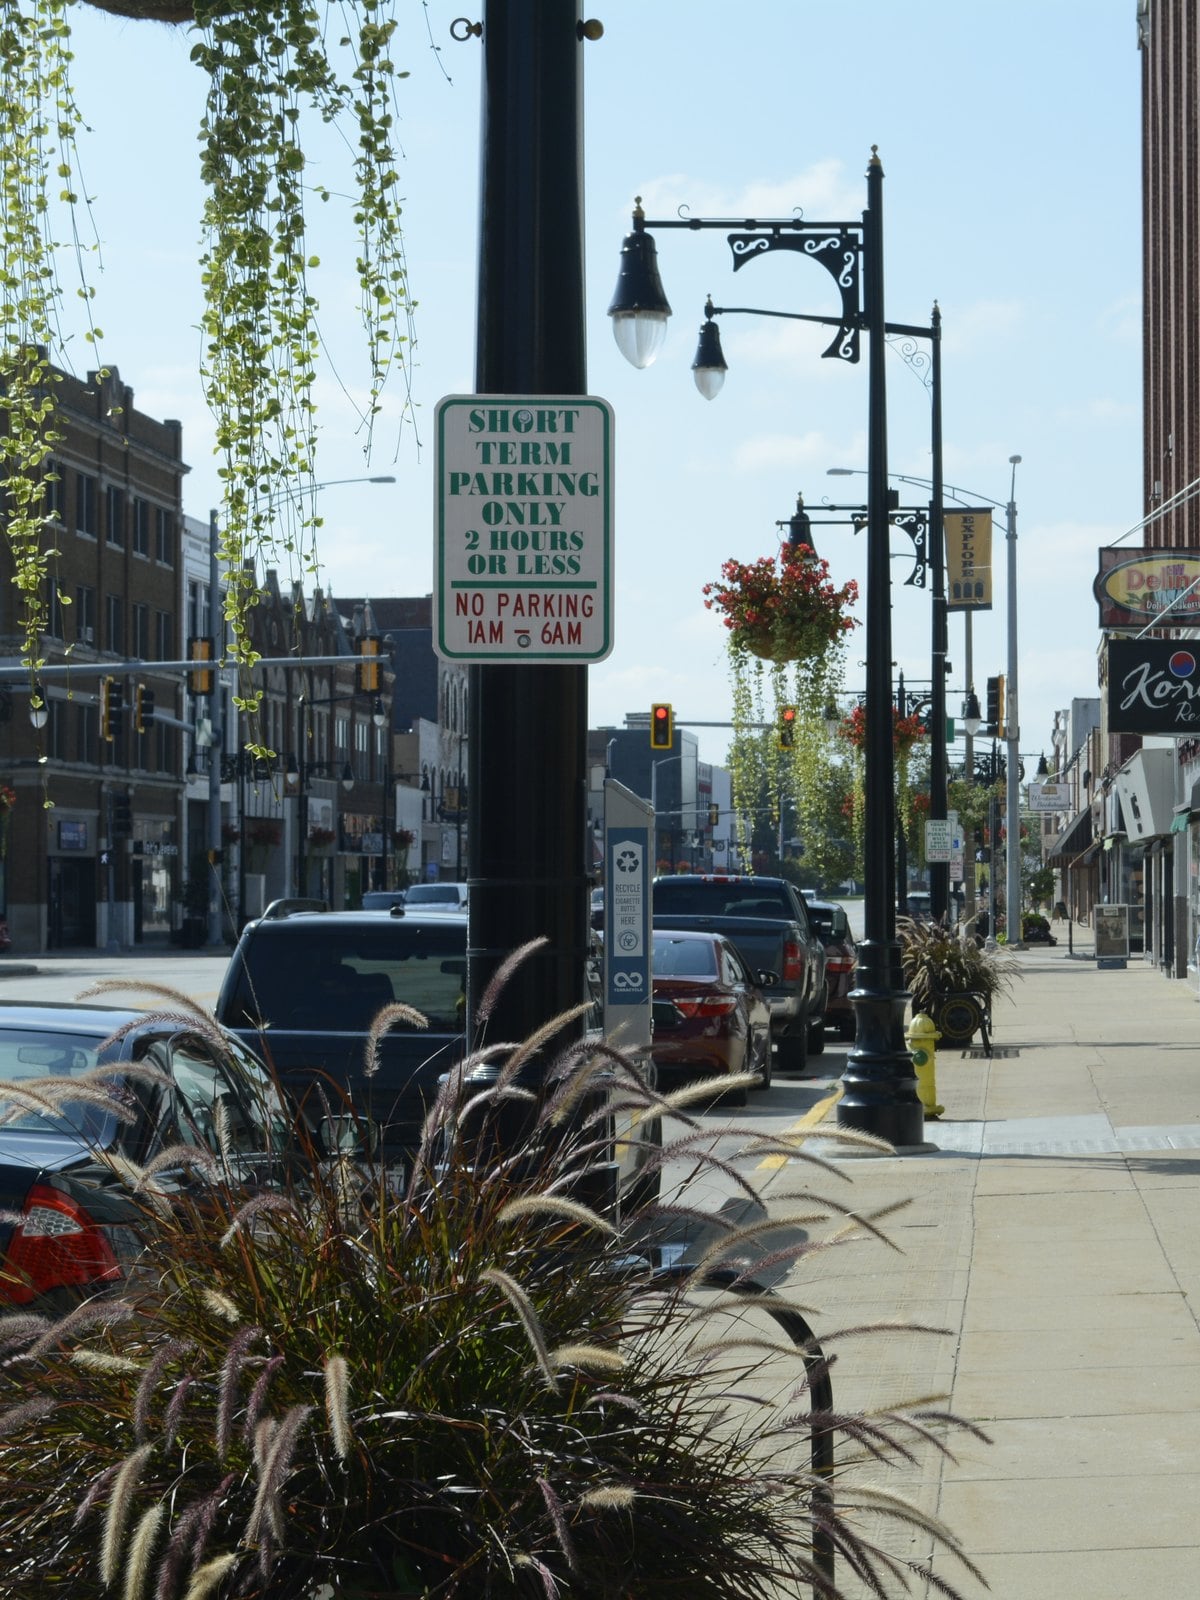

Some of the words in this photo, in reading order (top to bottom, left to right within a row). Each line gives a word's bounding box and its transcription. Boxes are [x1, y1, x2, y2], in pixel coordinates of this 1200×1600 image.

[468, 409, 579, 433] SHORT
[476, 441, 572, 465] TERM
[448, 472, 600, 496] PARKING
[482, 501, 566, 525] ONLY
[464, 530, 480, 550] 2
[489, 530, 584, 551] HOURS
[961, 516, 975, 577] EXPLORE
[467, 554, 507, 575] OR
[516, 554, 581, 575] LESS
[455, 592, 484, 616] NO
[497, 593, 594, 618] PARKING
[467, 620, 503, 644] 1AM
[541, 621, 582, 645] 6AM
[615, 884, 640, 893] RECYCLE
[620, 916, 636, 925] HERE
